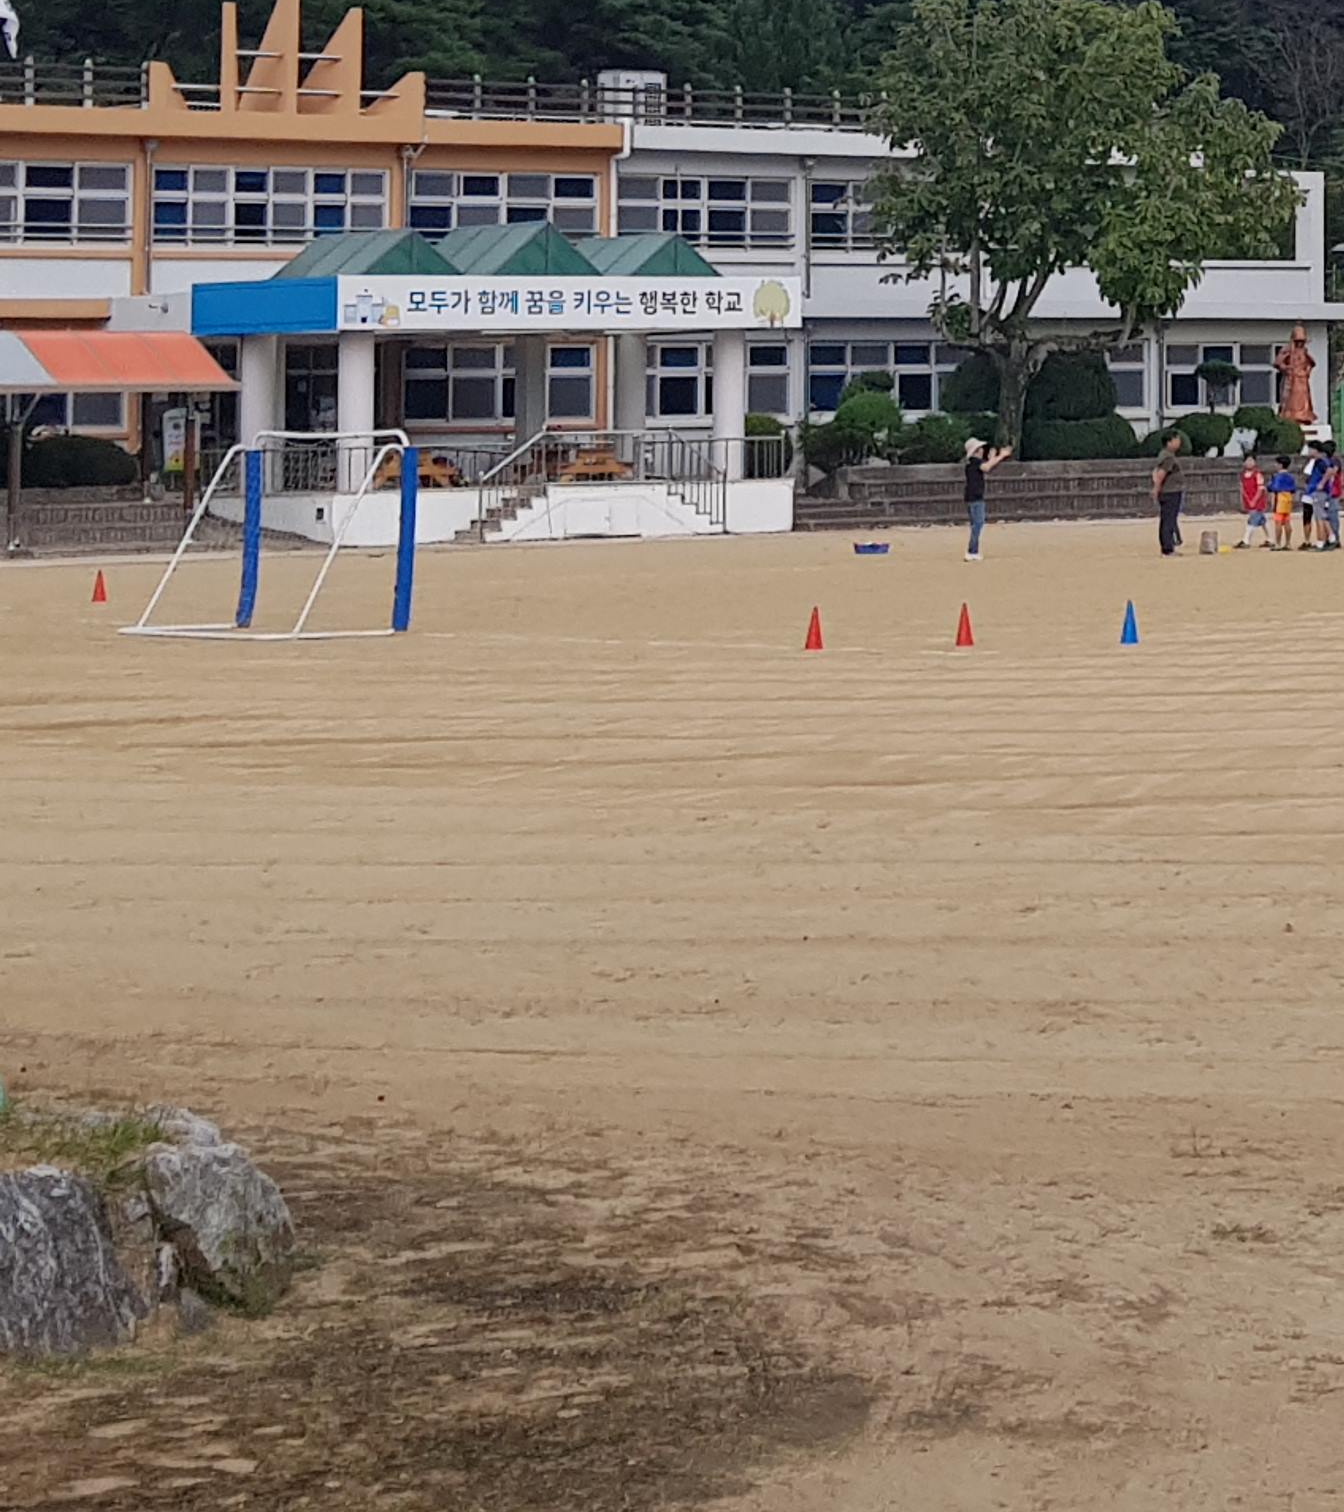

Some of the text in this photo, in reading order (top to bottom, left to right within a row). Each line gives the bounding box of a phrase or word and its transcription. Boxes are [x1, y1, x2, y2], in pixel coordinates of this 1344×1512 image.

[406, 289, 743, 316] 모두가 함께 꿈을 키우는 행복한 학교
